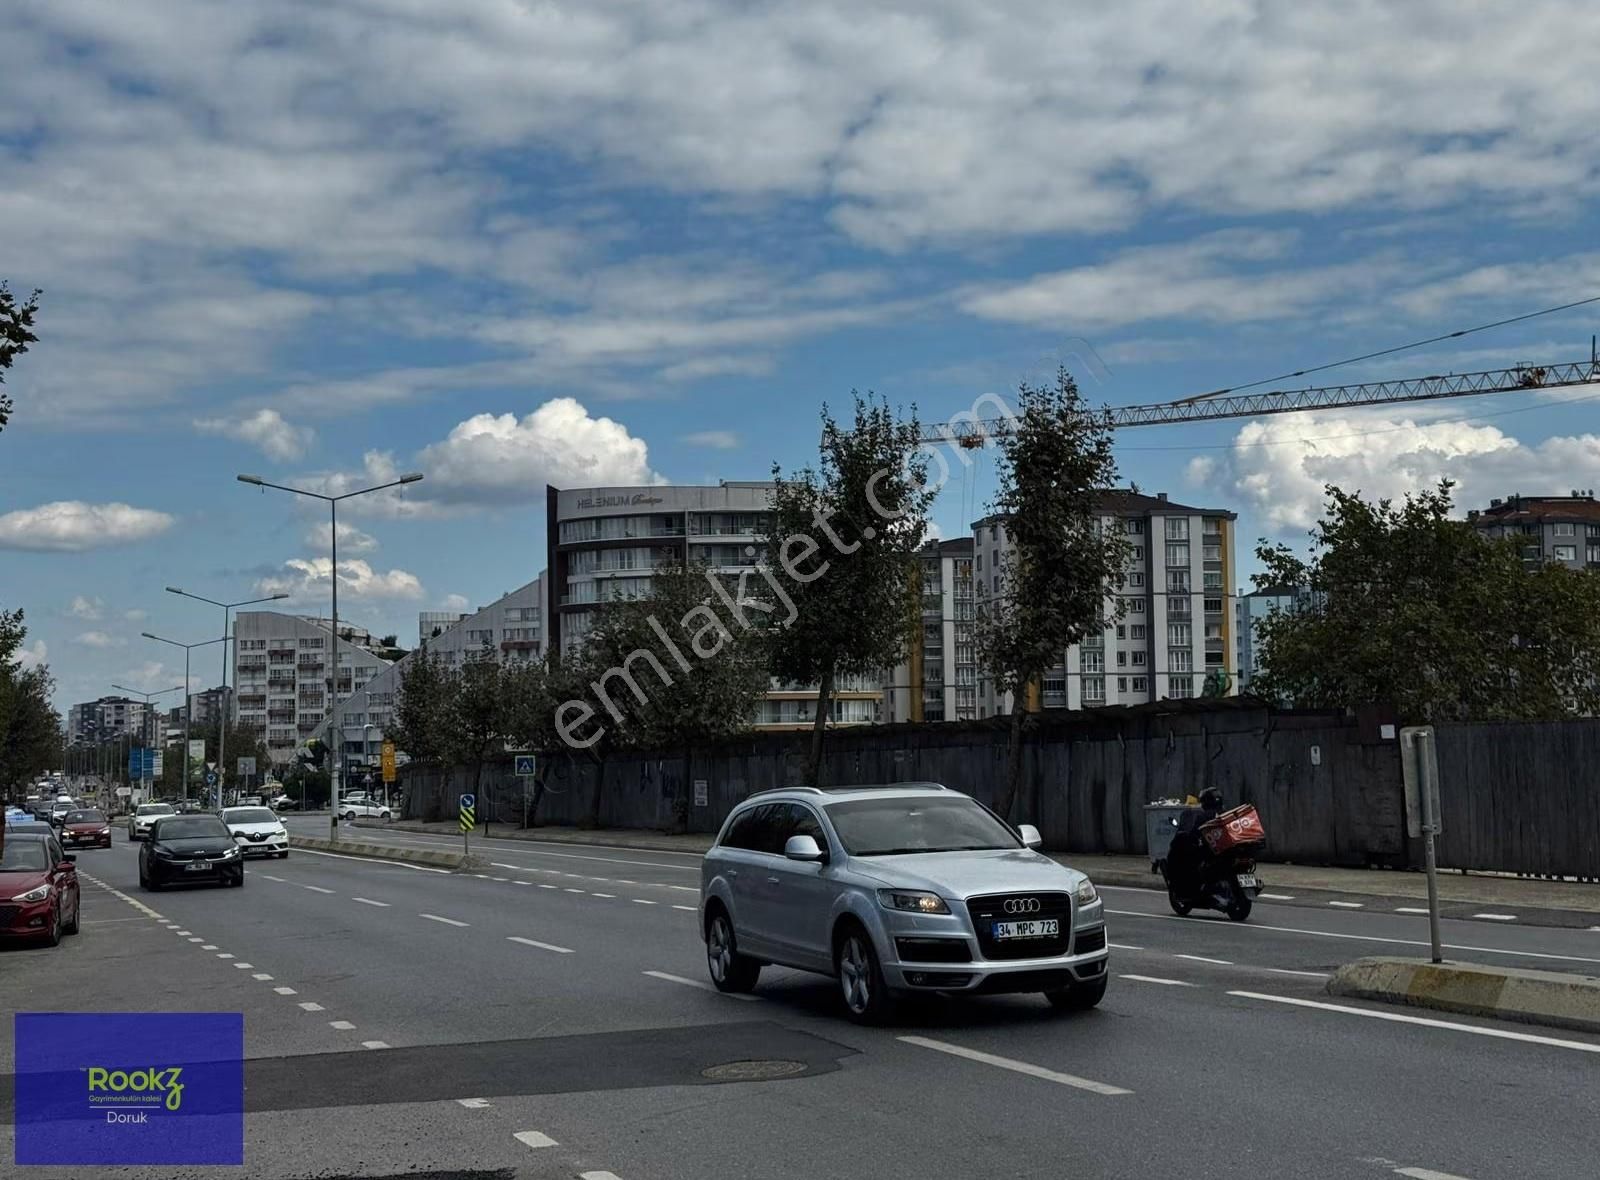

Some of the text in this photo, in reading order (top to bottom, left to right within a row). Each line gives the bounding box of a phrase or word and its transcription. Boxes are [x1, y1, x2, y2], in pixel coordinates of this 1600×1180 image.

[577, 496, 630, 509] HELENIUM
[999, 924, 1011, 936] 34
[1040, 921, 1058, 933] 723
